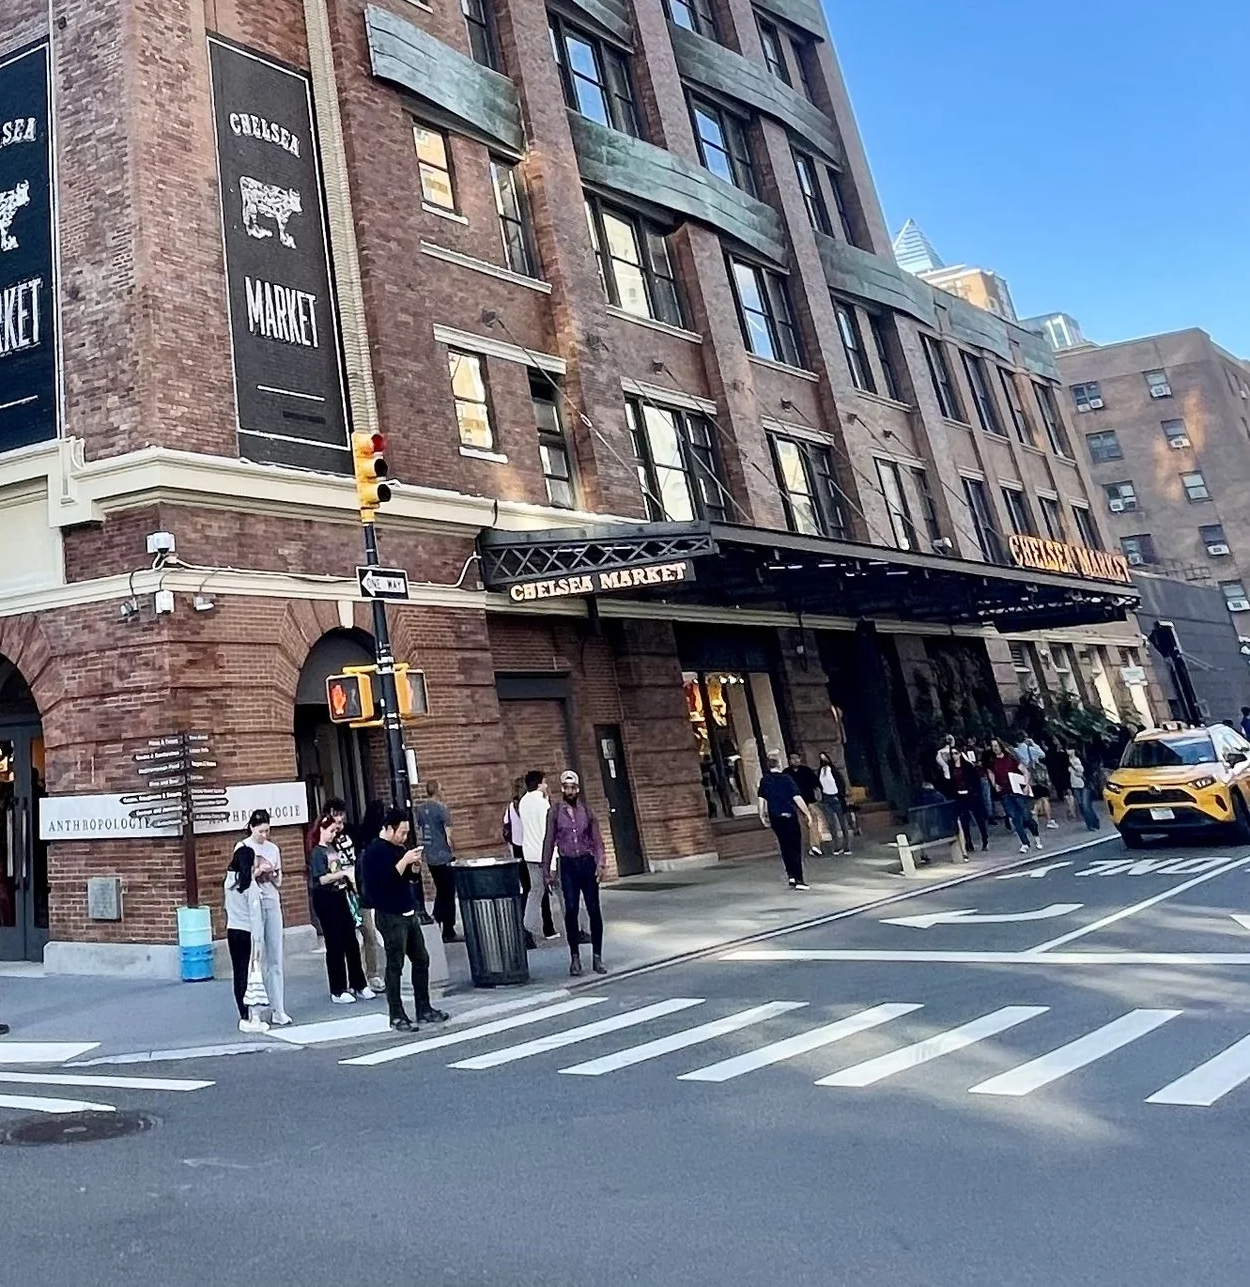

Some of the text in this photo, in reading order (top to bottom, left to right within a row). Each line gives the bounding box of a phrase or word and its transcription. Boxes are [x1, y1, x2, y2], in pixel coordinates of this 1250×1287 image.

[229, 113, 301, 158] CHELSEA
[245, 276, 319, 349] MARKET
[1009, 535, 1132, 583] CHELSEA MARKET
[366, 577, 401, 590] ONE WAY
[510, 563, 686, 601] CHELSEA MARKET
